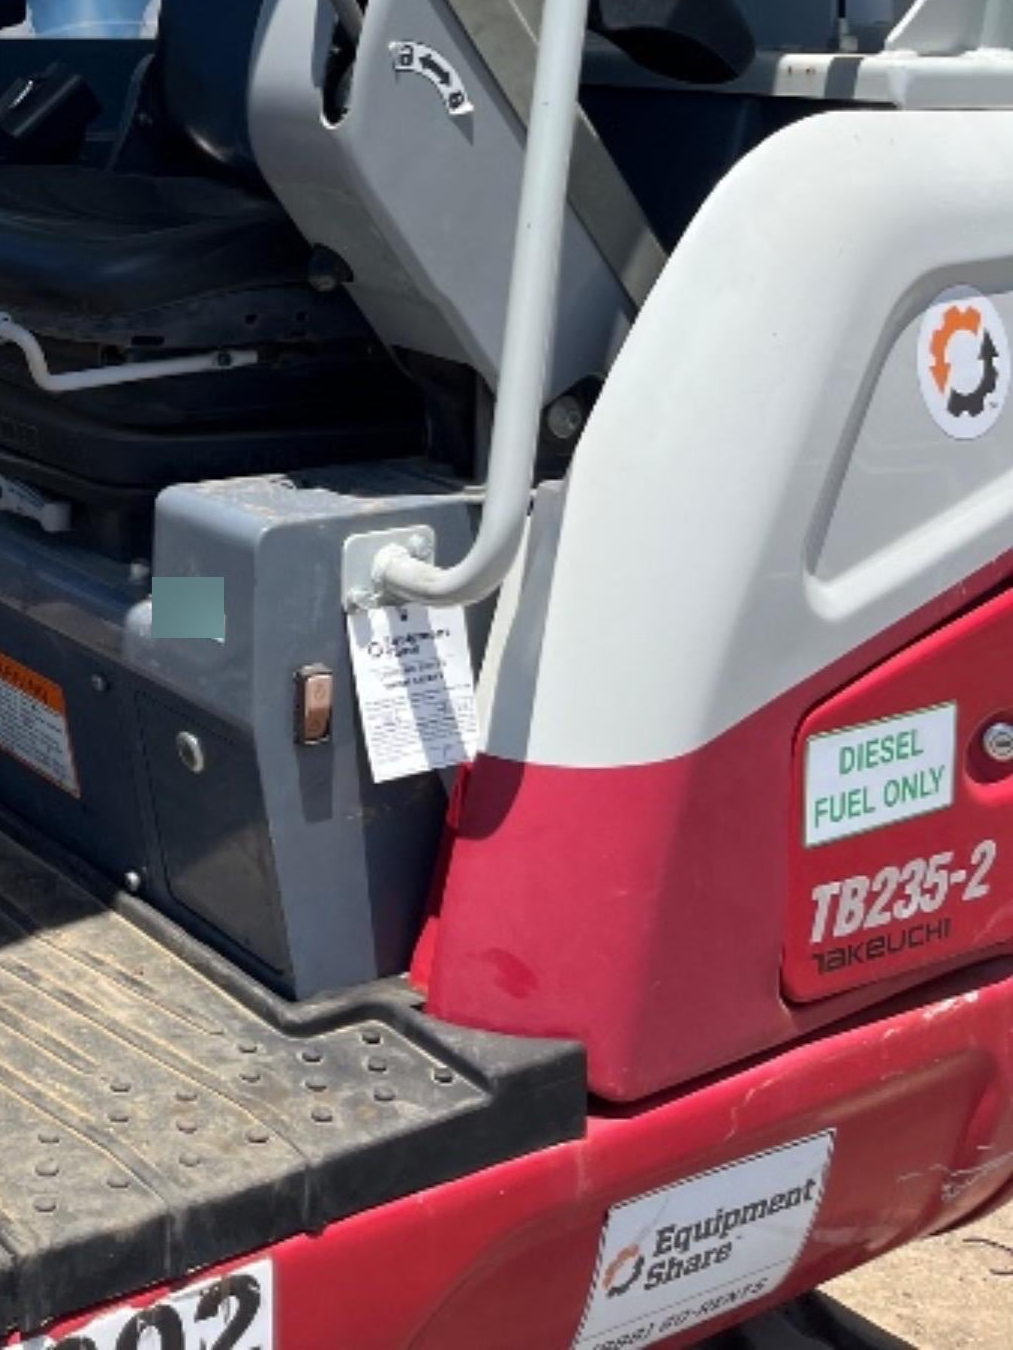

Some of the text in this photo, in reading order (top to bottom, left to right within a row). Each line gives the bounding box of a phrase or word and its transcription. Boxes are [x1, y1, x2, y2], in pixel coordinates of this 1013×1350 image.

[838, 728, 925, 776] DIESEL
[814, 764, 947, 829] FUEL ONLY
[809, 838, 997, 945] TB235-2
[652, 1177, 817, 1258] Equipment
[643, 1242, 733, 1292] Share
